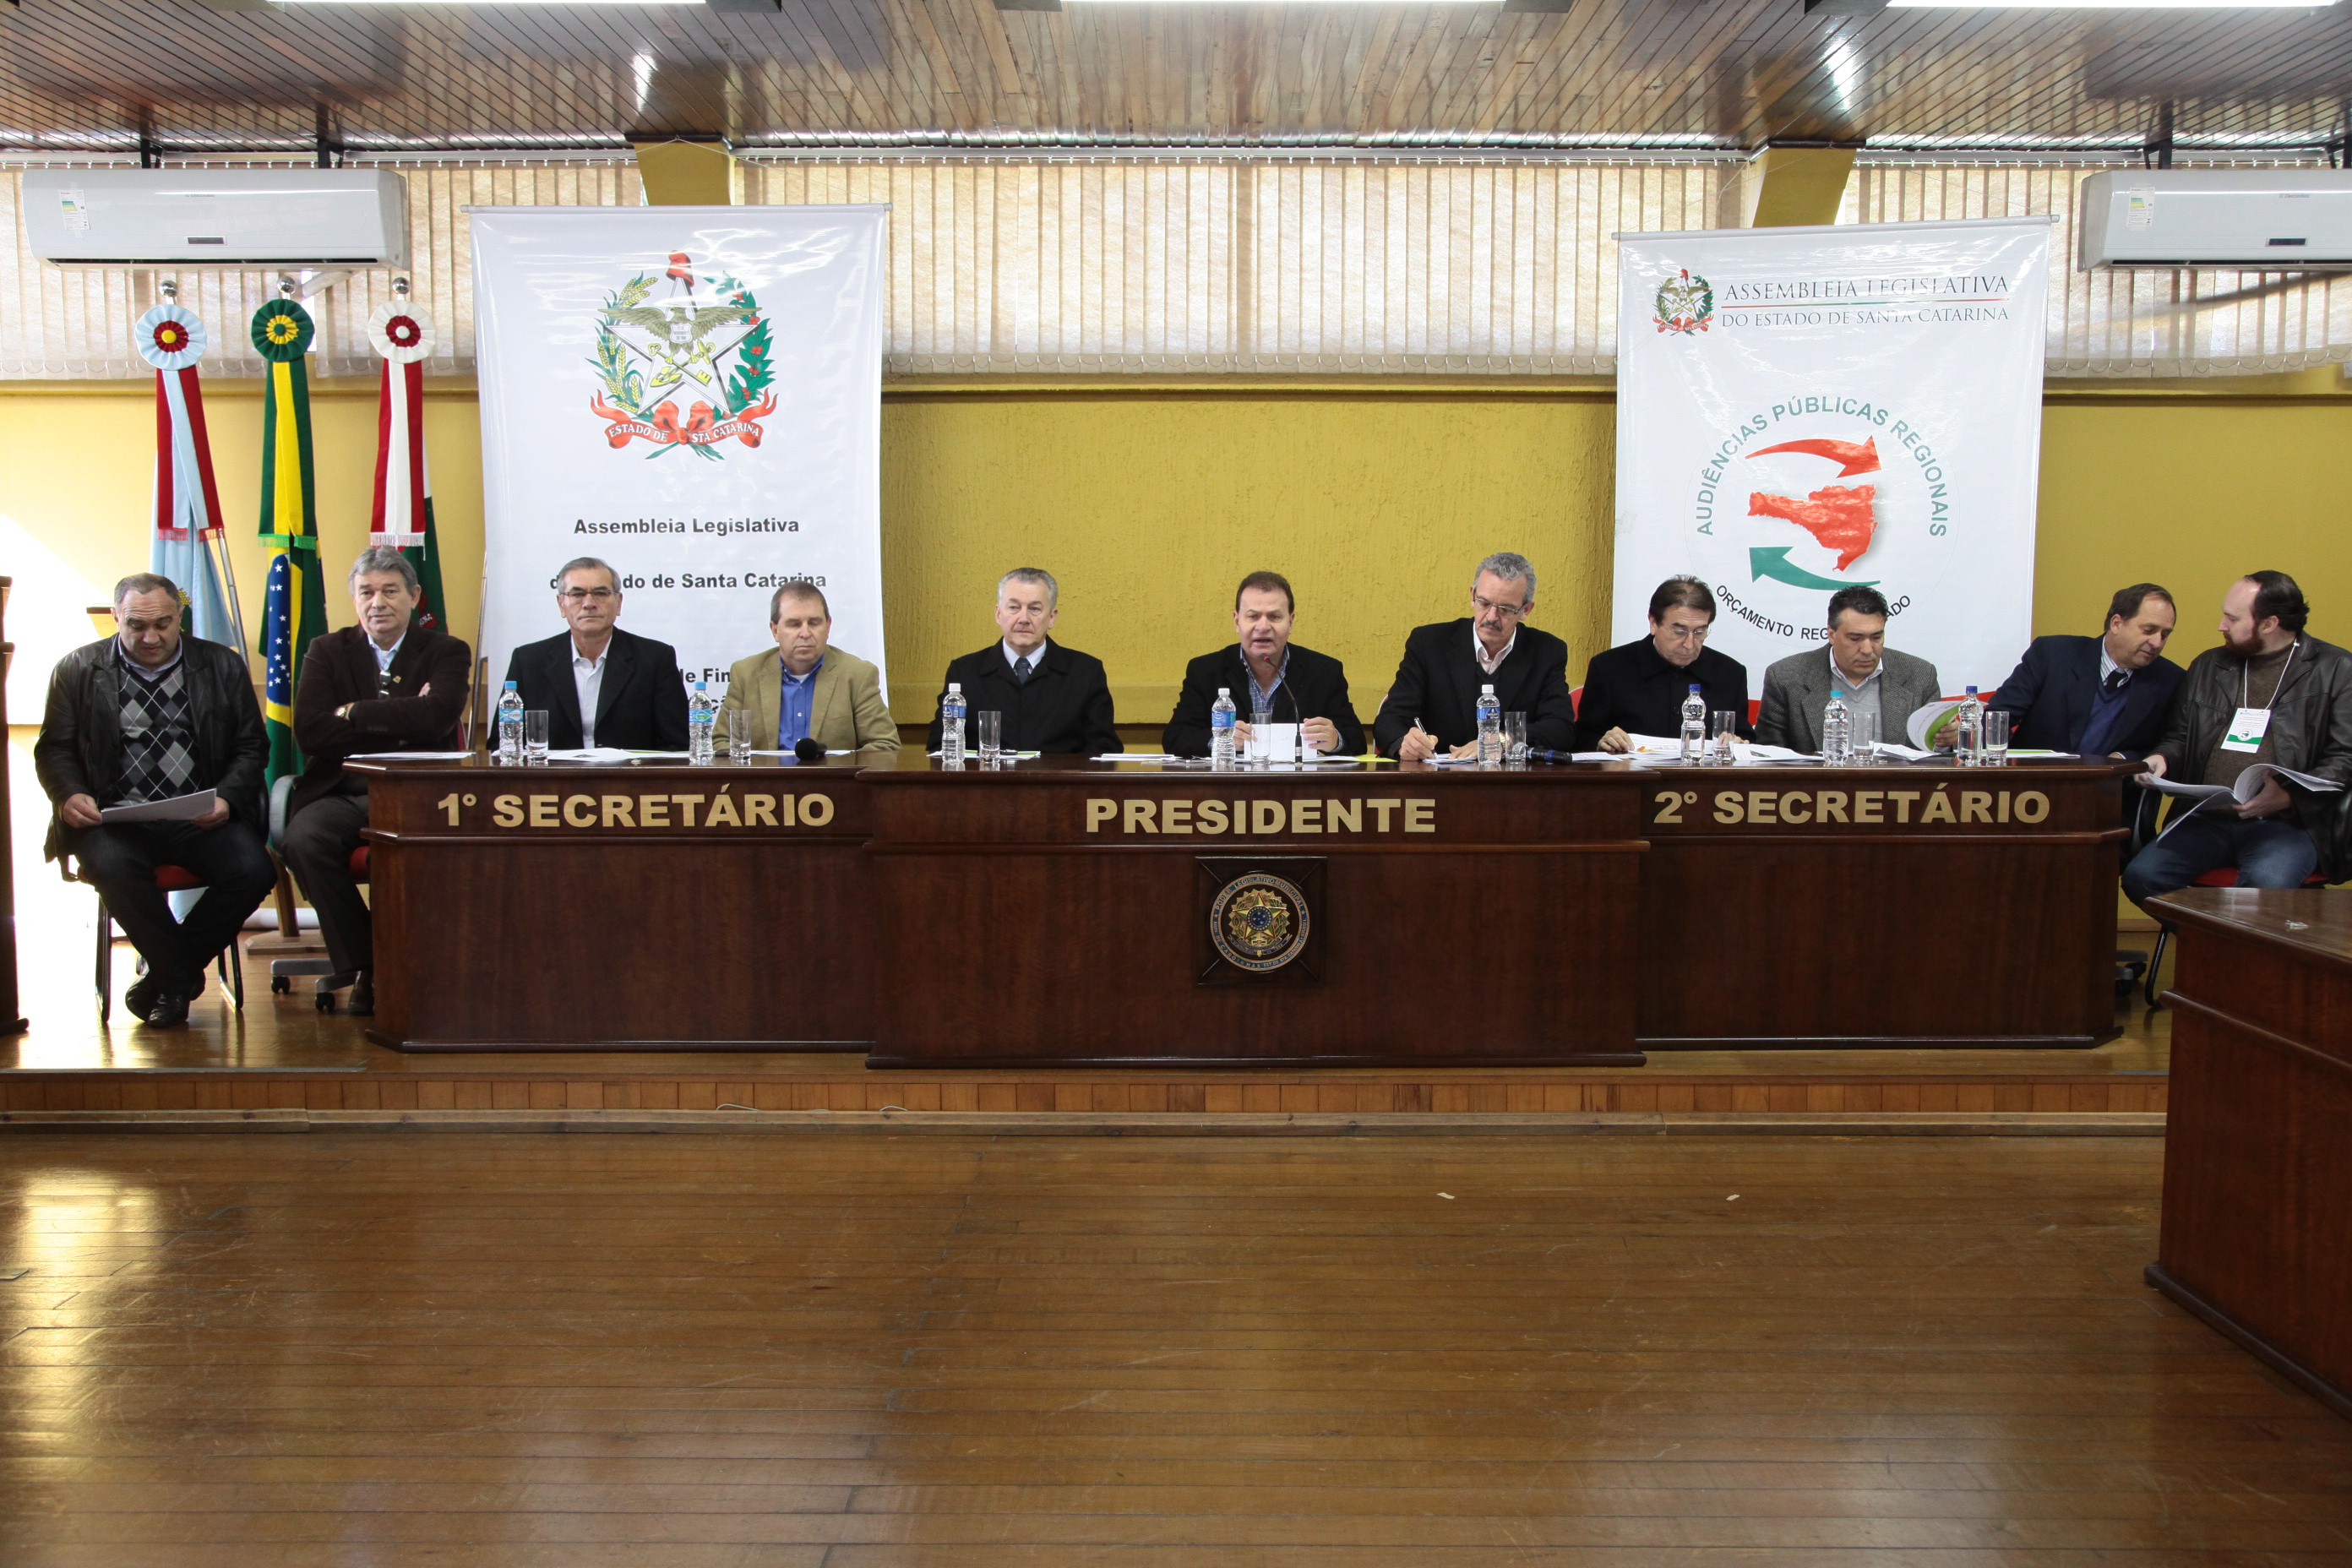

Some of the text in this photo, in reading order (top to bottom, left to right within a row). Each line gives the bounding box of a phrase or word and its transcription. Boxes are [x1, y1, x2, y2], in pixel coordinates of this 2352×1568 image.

[1724, 275, 2010, 301] ASSEMBLEIA LEGISLATIVA
[1722, 313, 1749, 328] DO
[1755, 311, 1821, 326] ESTADO
[1828, 311, 1850, 325] DE
[1856, 309, 1913, 324] SANTA
[1918, 307, 2010, 323] CATARINA
[608, 423, 651, 438] ESTADO
[652, 430, 667, 442] DE
[1696, 395, 1949, 537] AUDIÊNCIAS PÚBLICAS REGIONAIS
[574, 518, 799, 536] Assembleia Legislativa
[652, 574, 675, 588] de
[681, 573, 738, 589] Santa
[1716, 585, 1794, 637] ORÇAMENTO
[493, 782, 835, 828] SECRETÁRIO
[1086, 798, 1435, 834] PRESIDENTE
[1712, 782, 2050, 824] SECRETÁRIO
[1217, 888, 1233, 910] PODER
[1275, 879, 1304, 908] MUNICIPAL
